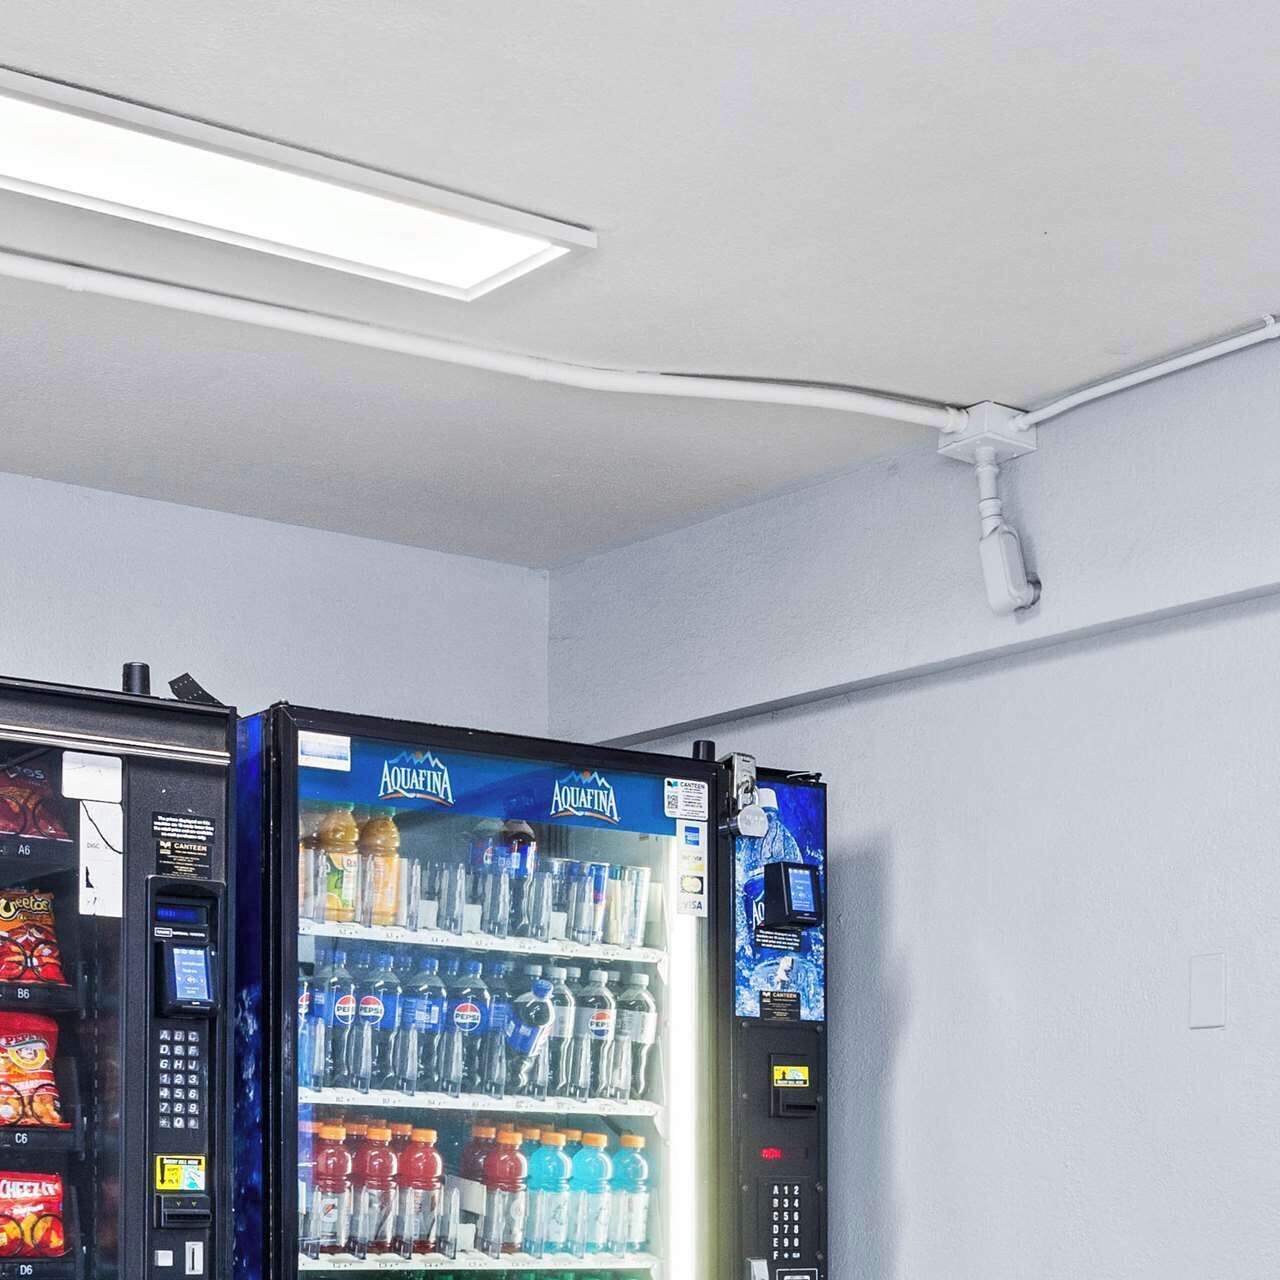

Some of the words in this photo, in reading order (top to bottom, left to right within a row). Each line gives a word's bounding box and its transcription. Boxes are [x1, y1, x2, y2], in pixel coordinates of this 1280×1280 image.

[378, 761, 455, 805] AQUAFINA
[680, 782, 705, 790] CANTEEN
[550, 780, 620, 823] AQUAFINA
[18, 845, 31, 856] A6
[174, 843, 207, 851] CANTEEN
[17, 987, 30, 999] B6
[359, 1006, 384, 1014] PEPSI
[455, 1012, 480, 1021] PEPSI
[15, 1133, 28, 1144] C6
[772, 1185, 779, 1195] A
[783, 1185, 789, 1195] 1
[793, 1186, 799, 1195] 2
[772, 1198, 779, 1208] B
[783, 1199, 789, 1208] 3
[793, 1199, 799, 1208] 4
[772, 1211, 779, 1221] C
[783, 1211, 789, 1221] 5
[793, 1212, 799, 1221] 6
[772, 1225, 779, 1234] D
[783, 1225, 789, 1234] 7
[793, 1225, 799, 1234] 8
[772, 1238, 779, 1247] E
[783, 1238, 789, 1247] 9
[793, 1238, 799, 1247] 0
[772, 1251, 779, 1260] F
[20, 1265, 33, 1275] D6
